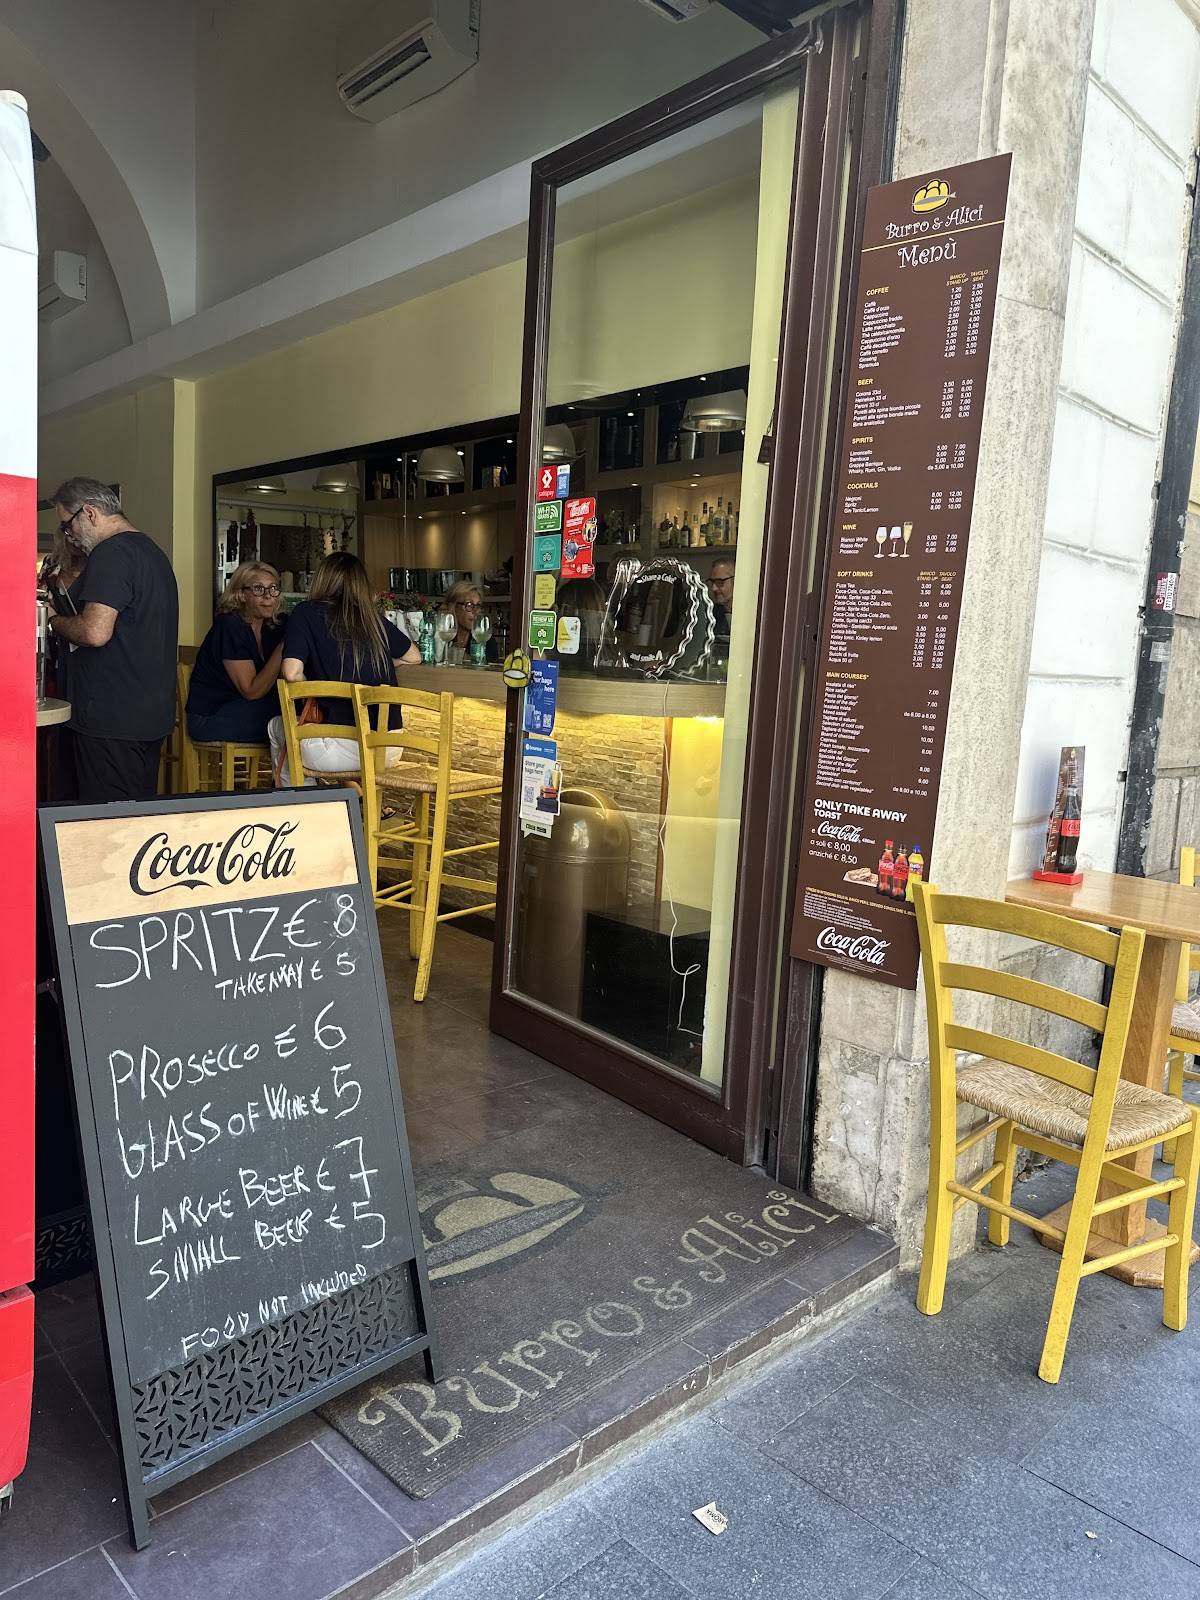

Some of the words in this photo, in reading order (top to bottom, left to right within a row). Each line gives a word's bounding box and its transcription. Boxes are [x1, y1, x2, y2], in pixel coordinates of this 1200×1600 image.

[885, 222, 930, 240] Burro
[932, 217, 943, 230] &
[945, 204, 983, 227] Alici
[897, 238, 957, 268] Menù
[866, 287, 889, 296] COFFEE
[851, 436, 873, 444] SPIRITS
[814, 809, 842, 820] TOAST
[815, 799, 842, 811] ONLY
[843, 803, 871, 816] TAKE
[872, 809, 907, 822] AWAY
[817, 821, 864, 843] Coca-Cola
[834, 842, 850, 852] 8,00
[130, 820, 300, 896] Coca-Cola
[809, 849, 832, 859] anziché
[841, 854, 857, 864] 8,50
[90, 906, 286, 988] SPRITZ
[333, 894, 357, 937] 8
[817, 927, 891, 965] Coca-Cola
[336, 952, 356, 975] 5
[108, 1043, 260, 1121] PROSECCO
[274, 1024, 298, 1058] €
[314, 1001, 347, 1050] 6
[117, 1102, 221, 1179] GLASS
[228, 1101, 259, 1135] OF
[331, 1063, 362, 1120] 5
[134, 1189, 234, 1246] LARGE
[239, 1165, 310, 1208] BEER
[334, 1136, 379, 1199] 7
[146, 1235, 241, 1300] SMALL
[254, 1208, 314, 1250] BEER
[352, 1200, 386, 1249] 5
[181, 1311, 250, 1359] FOOD
[259, 1296, 288, 1325] NOT
[358, 1300, 647, 1458] Burro
[632, 1275, 696, 1312] &
[678, 1188, 842, 1284] Alici
